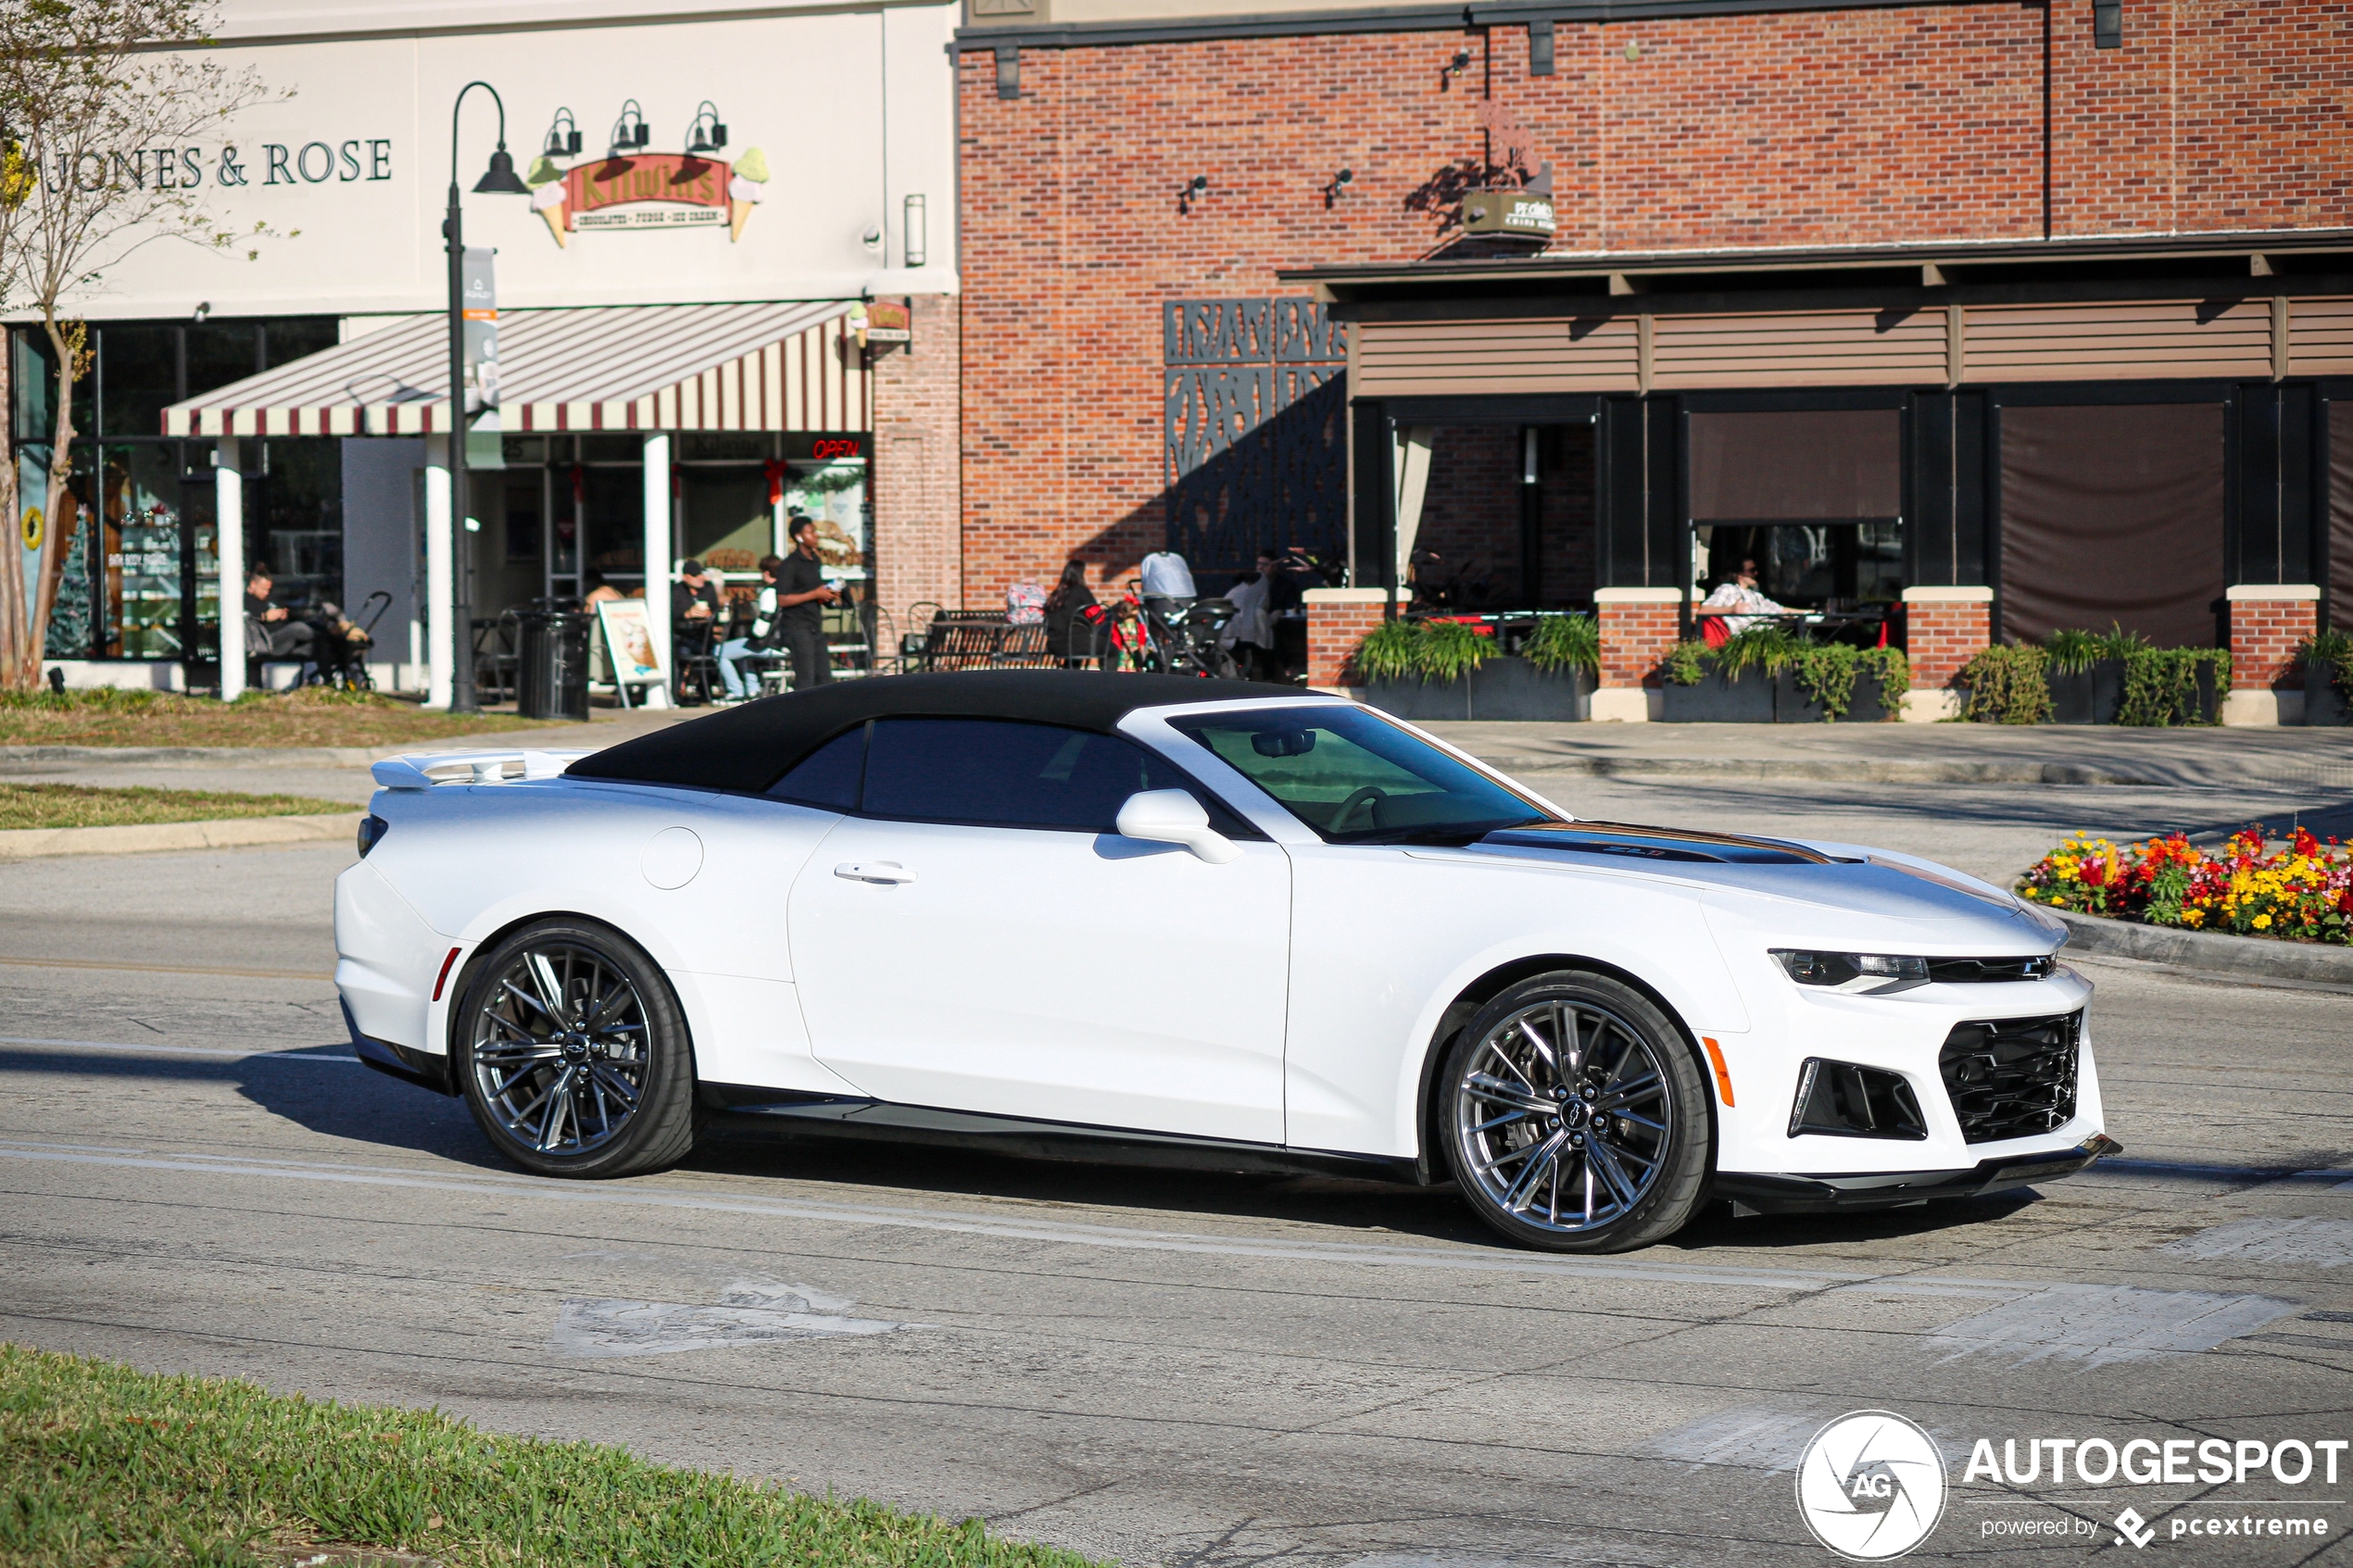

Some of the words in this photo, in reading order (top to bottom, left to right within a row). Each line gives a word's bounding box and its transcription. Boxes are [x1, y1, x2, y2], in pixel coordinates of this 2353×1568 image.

[47, 146, 201, 194] JONES
[216, 145, 248, 186] &
[261, 139, 392, 186] ROSE
[581, 161, 715, 207] Kilwins
[635, 212, 664, 223] FUDGE
[673, 212, 686, 221] ICE
[689, 211, 719, 221] CREAM
[812, 439, 861, 460] OPEN
